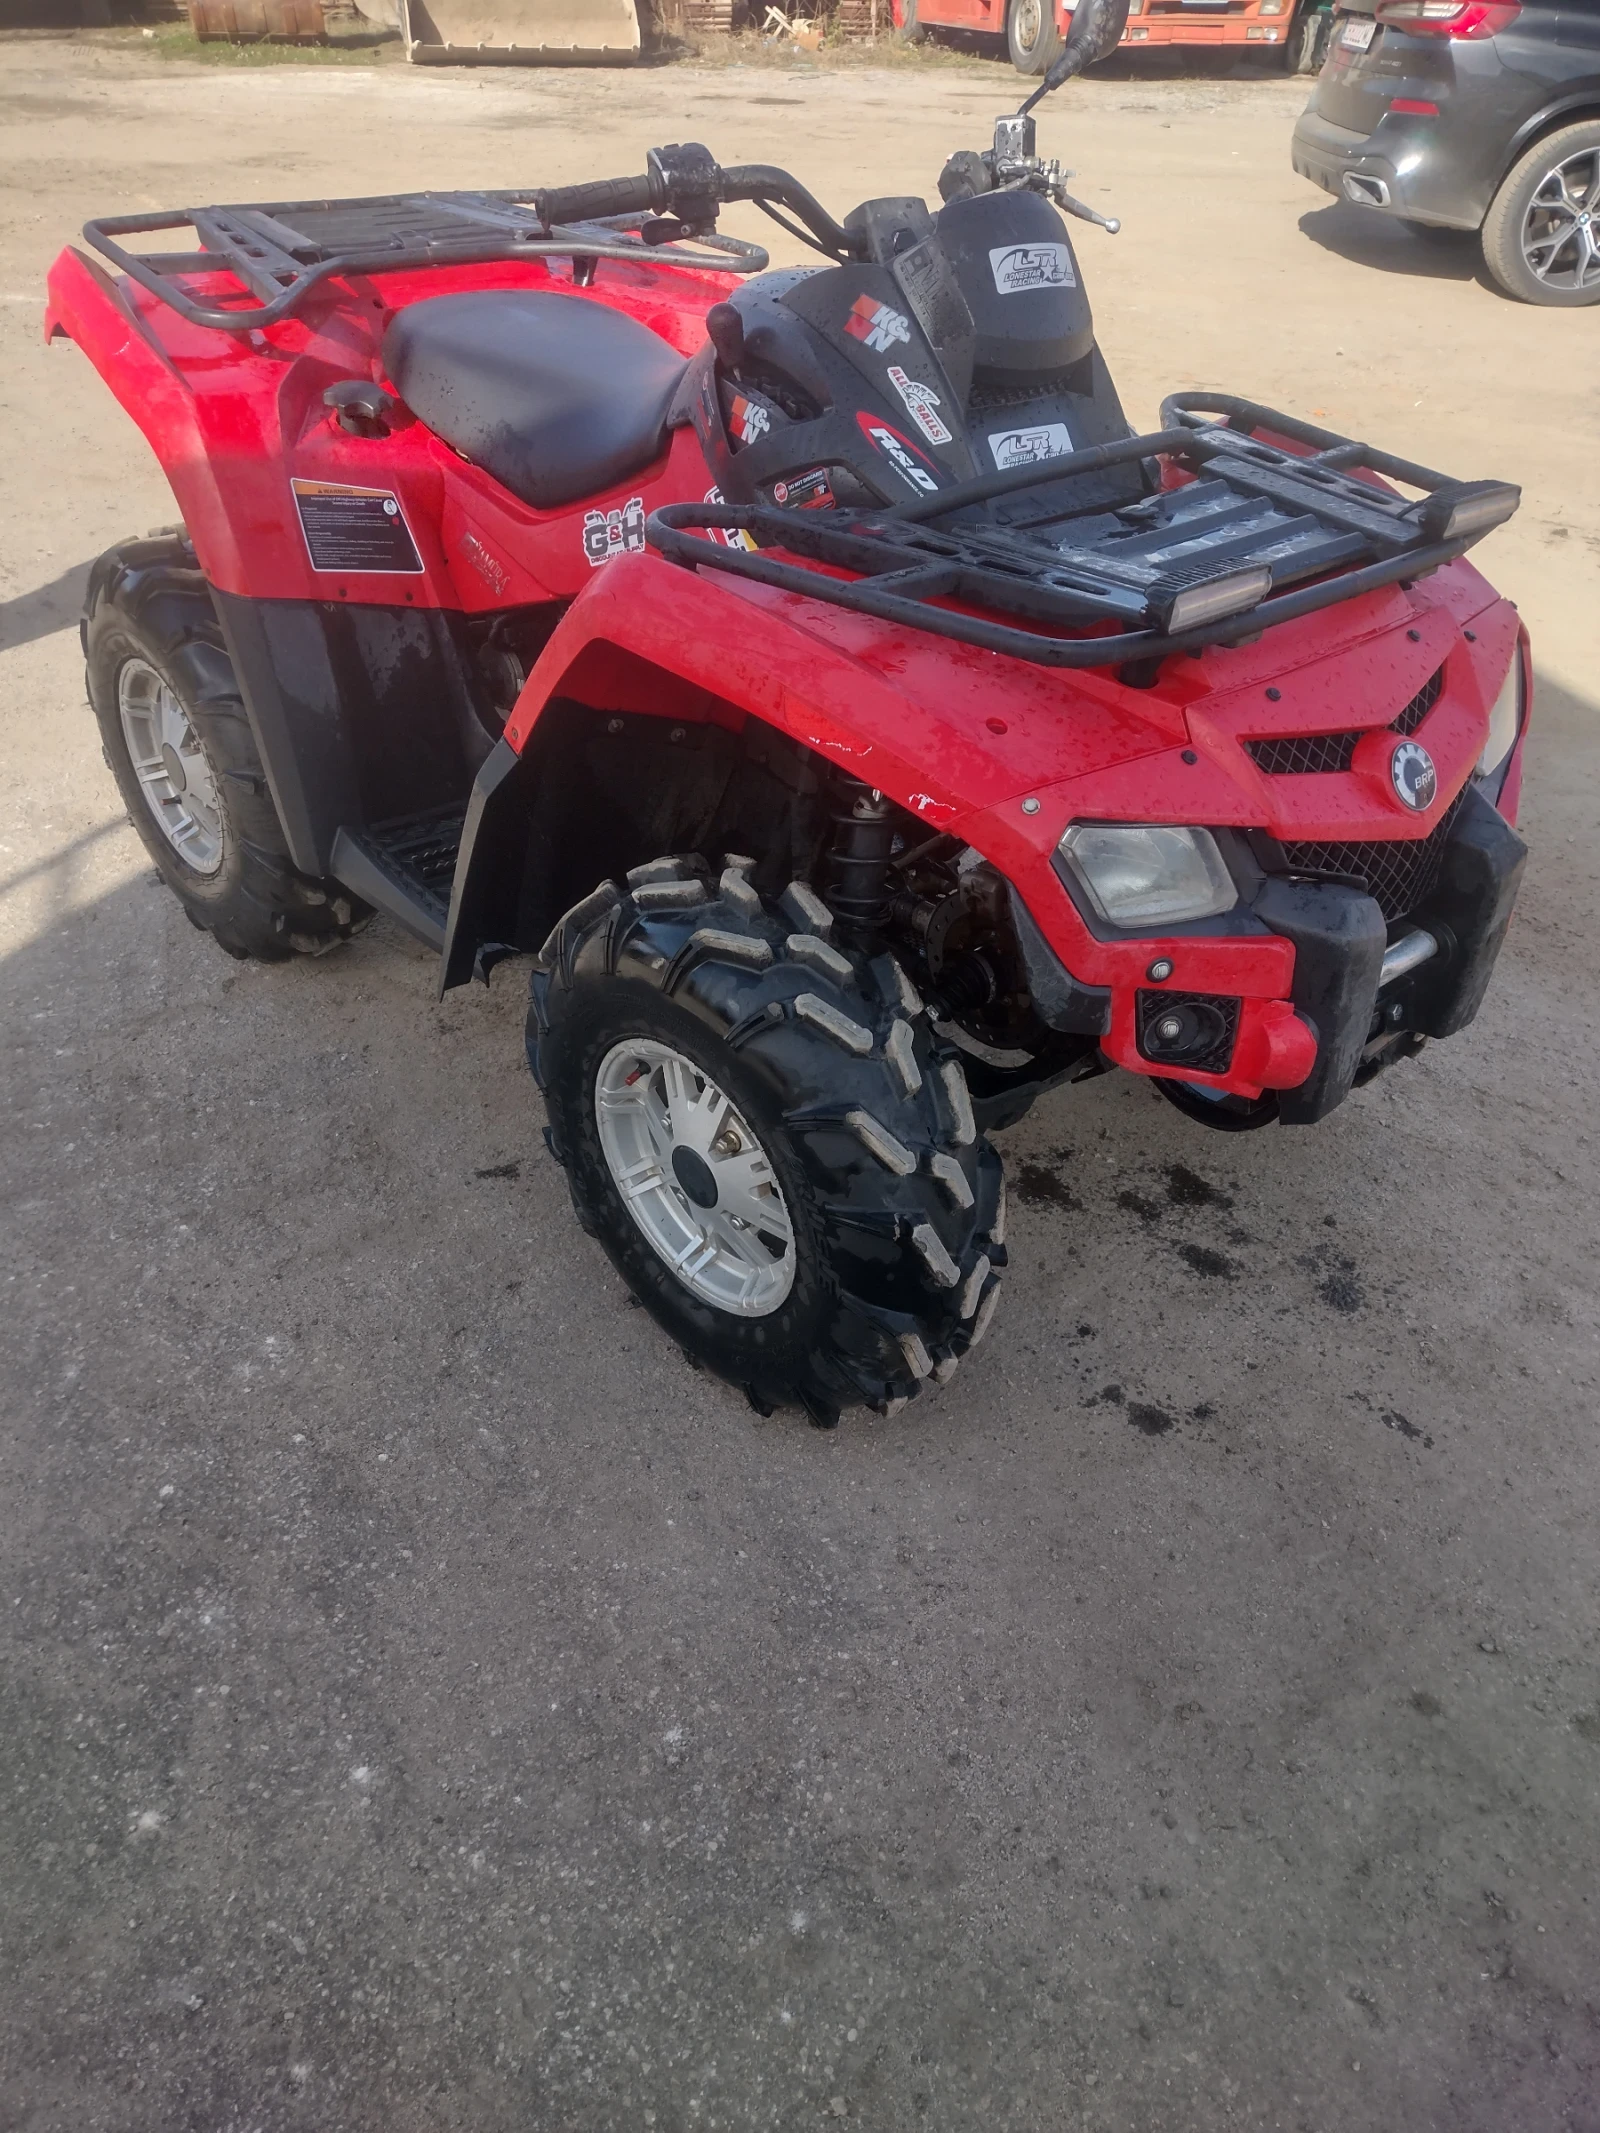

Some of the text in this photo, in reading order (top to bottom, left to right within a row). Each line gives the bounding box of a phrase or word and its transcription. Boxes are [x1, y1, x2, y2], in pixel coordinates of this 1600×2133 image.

[1013, 249, 1057, 271] LSR
[1003, 269, 1041, 283] LONESTAR
[1010, 277, 1041, 288] RACING
[889, 368, 943, 438] ALL BALLS
[1009, 431, 1051, 455] LSR
[868, 428, 939, 490] R&D
[1002, 452, 1035, 466] LONESTAR
[585, 512, 644, 557] G&H
[1414, 769, 1434, 789] BRP
